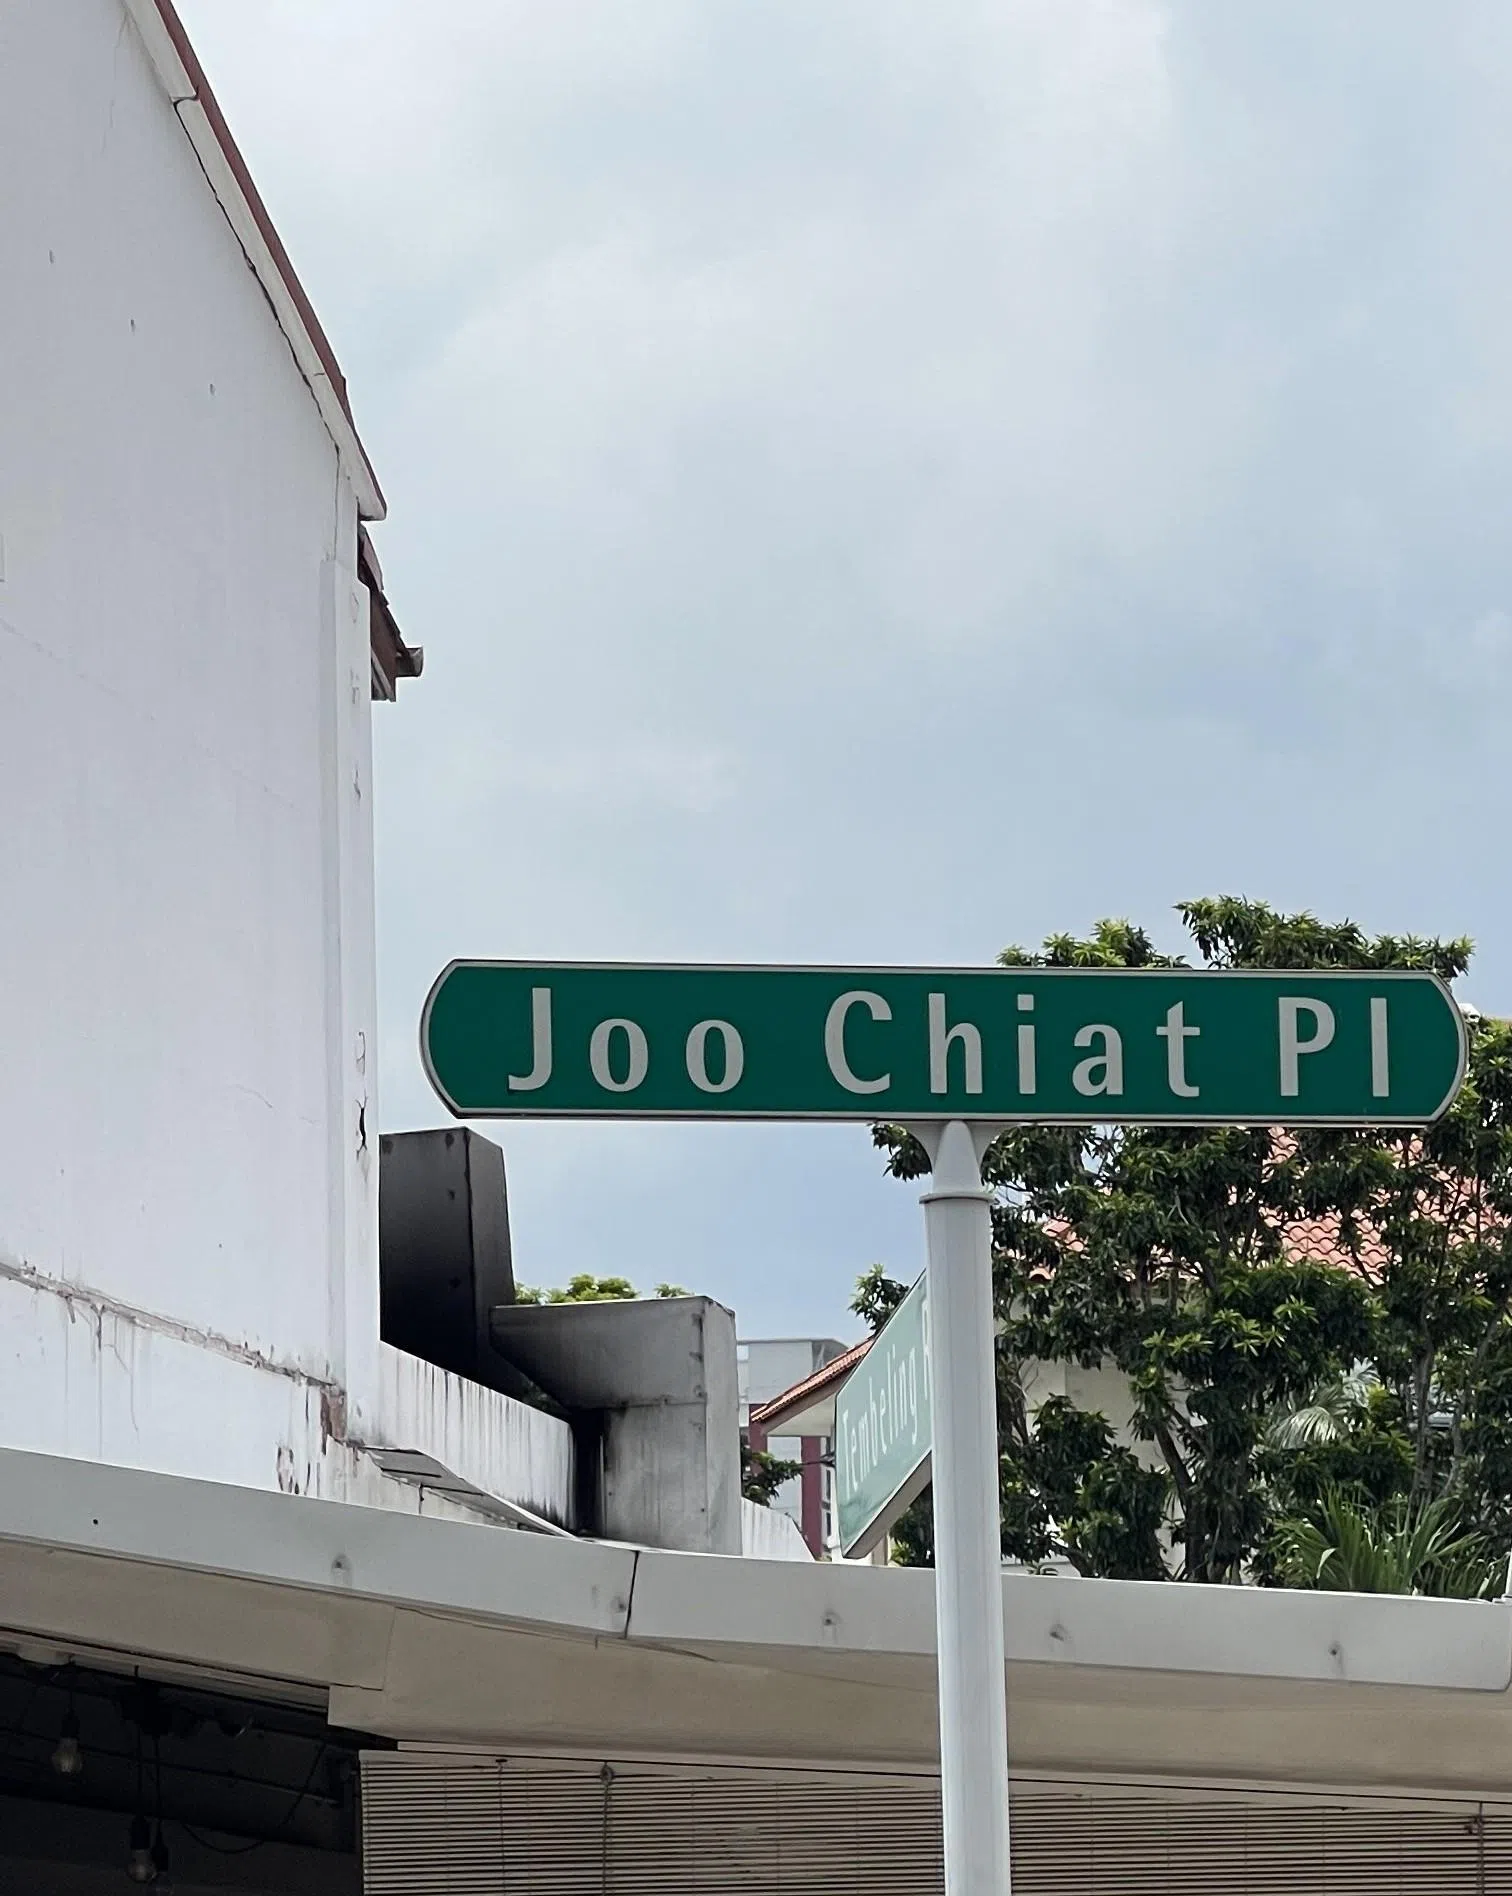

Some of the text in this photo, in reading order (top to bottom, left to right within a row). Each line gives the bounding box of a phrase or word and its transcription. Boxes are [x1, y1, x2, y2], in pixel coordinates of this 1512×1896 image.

[508, 987, 1389, 1098] Joo Chiat Pl
[842, 1343, 918, 1499] Tembeling
